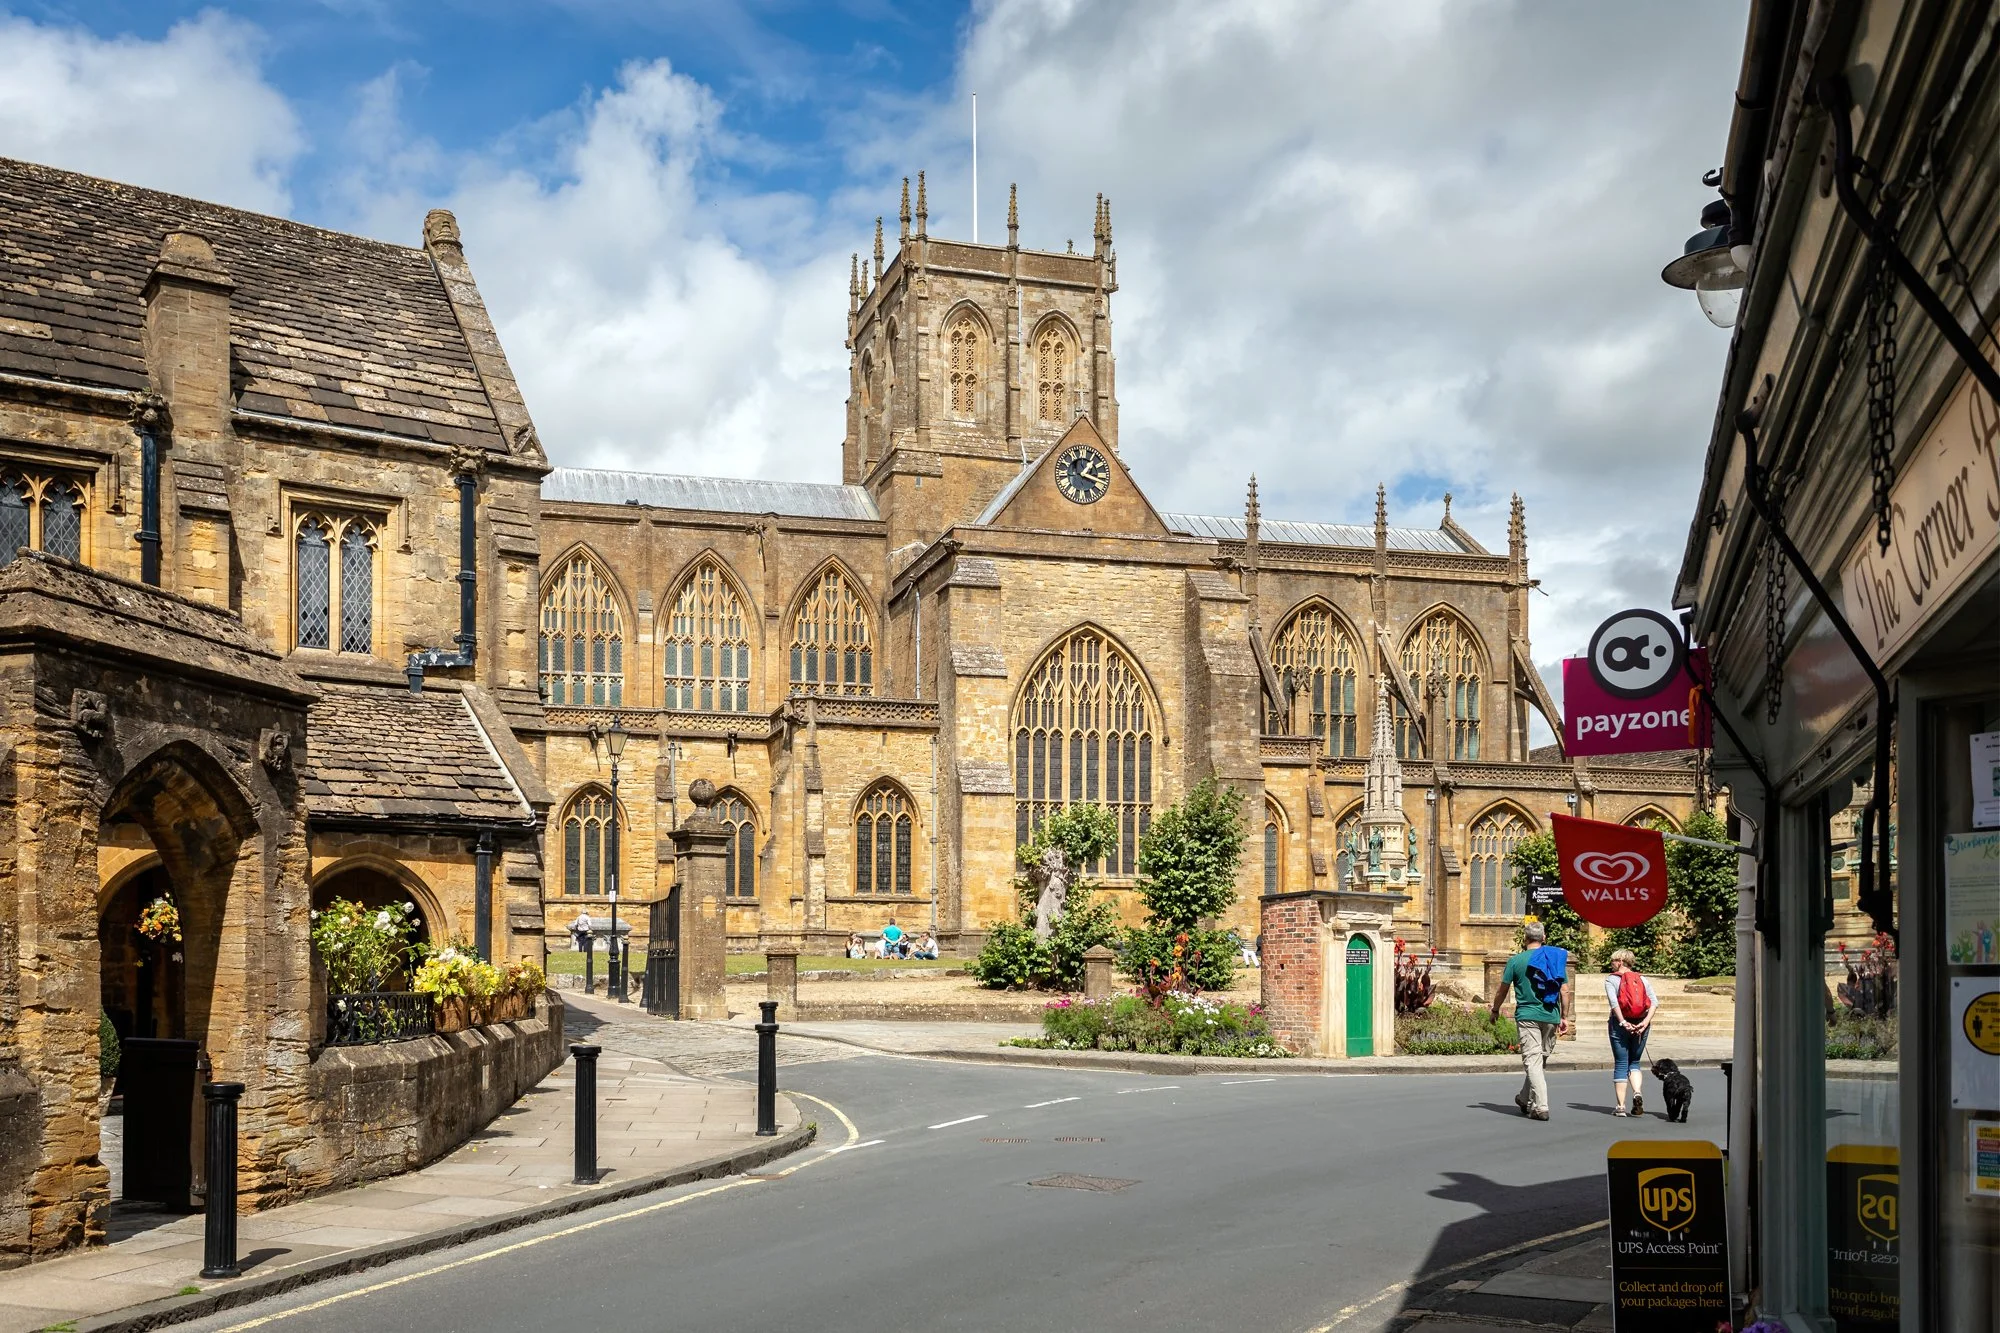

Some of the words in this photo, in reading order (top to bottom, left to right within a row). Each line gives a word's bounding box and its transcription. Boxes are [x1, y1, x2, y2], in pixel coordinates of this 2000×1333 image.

[1854, 540, 1900, 650] The
[1893, 466, 1974, 606] Corner
[1576, 708, 1695, 740] payzone
[1581, 888, 1649, 901] WALL'S
[1643, 1187, 1692, 1221] ups
[1618, 1242, 1643, 1254] UPS
[1646, 1242, 1685, 1254] Access
[1619, 1281, 1656, 1293] Collect
[1658, 1282, 1679, 1293] and
[1681, 1282, 1707, 1295] drop
[1708, 1282, 1724, 1293] off
[1621, 1297, 1646, 1309] your
[1648, 1296, 1697, 1309] packages
